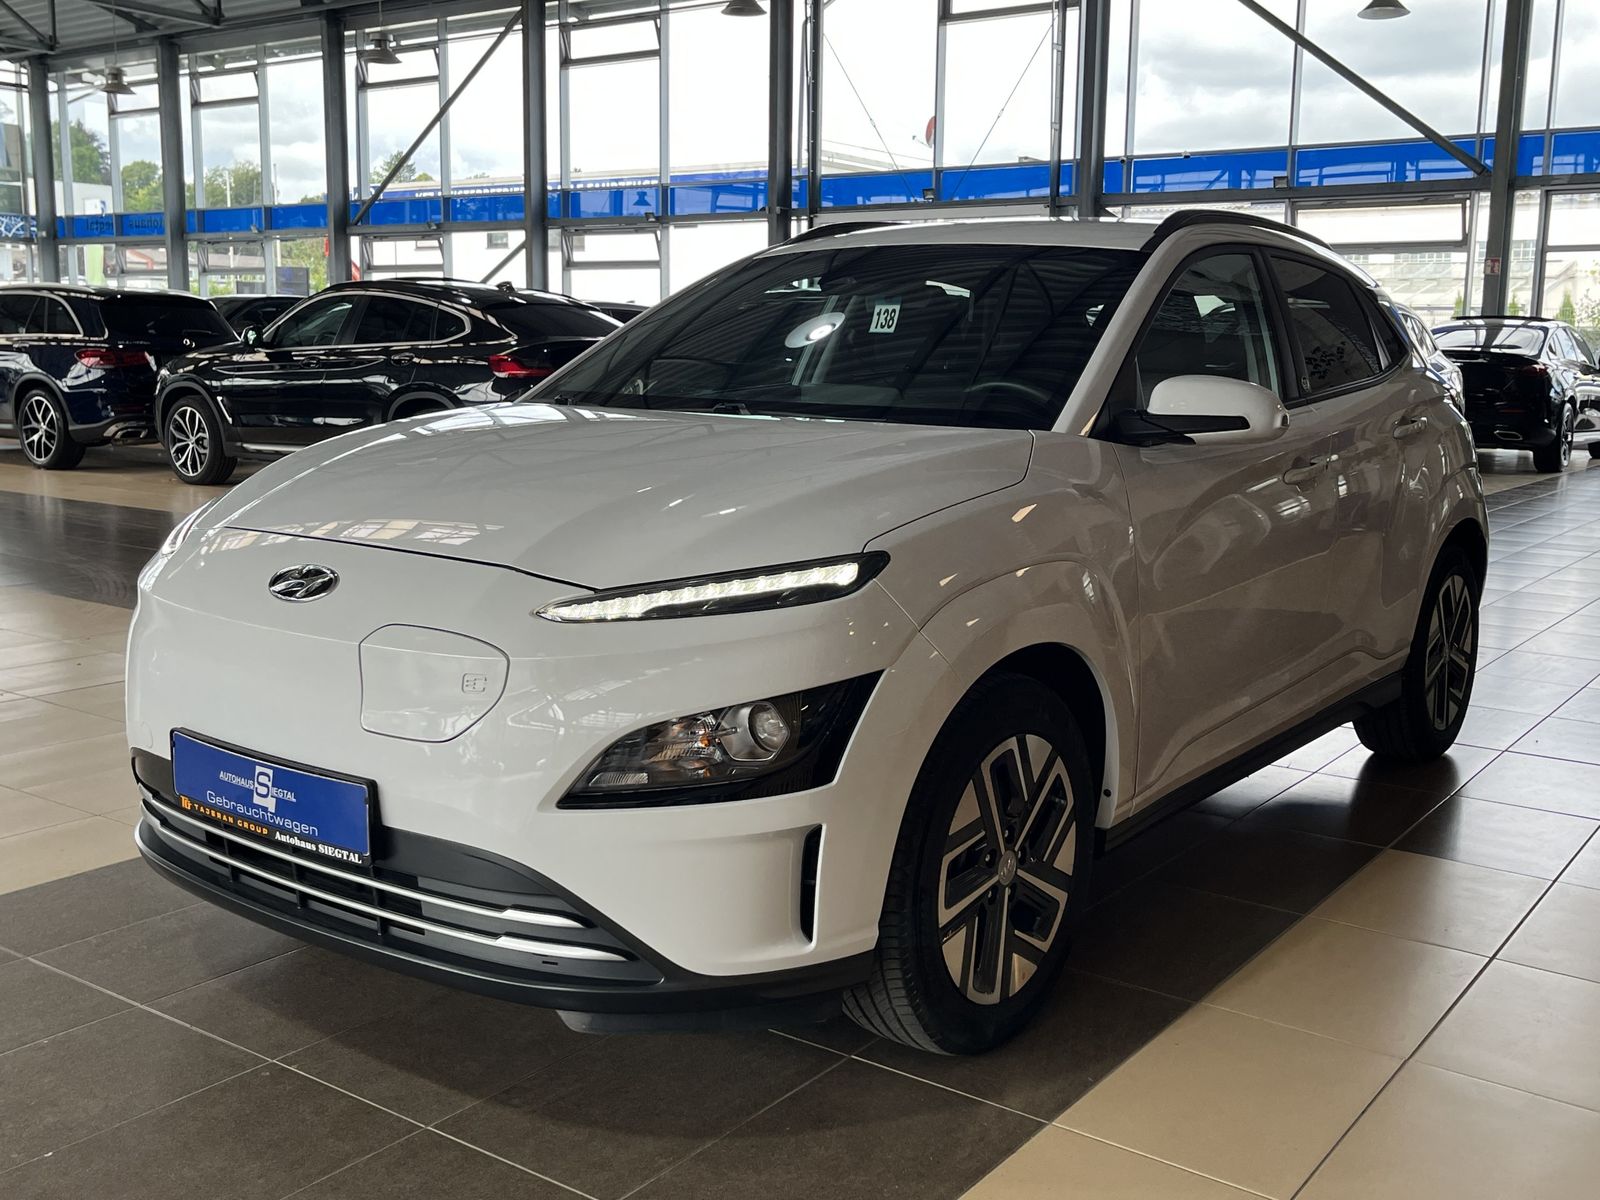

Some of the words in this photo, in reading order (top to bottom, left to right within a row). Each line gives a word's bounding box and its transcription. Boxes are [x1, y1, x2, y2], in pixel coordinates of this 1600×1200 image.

[874, 308, 897, 329] 138
[219, 770, 254, 789] AUTOHAUS
[206, 790, 319, 836] Gebrauchtwagen
[237, 818, 269, 835] GROUP
[274, 831, 317, 851] Autohaus
[318, 843, 362, 864] SIEGTAL
